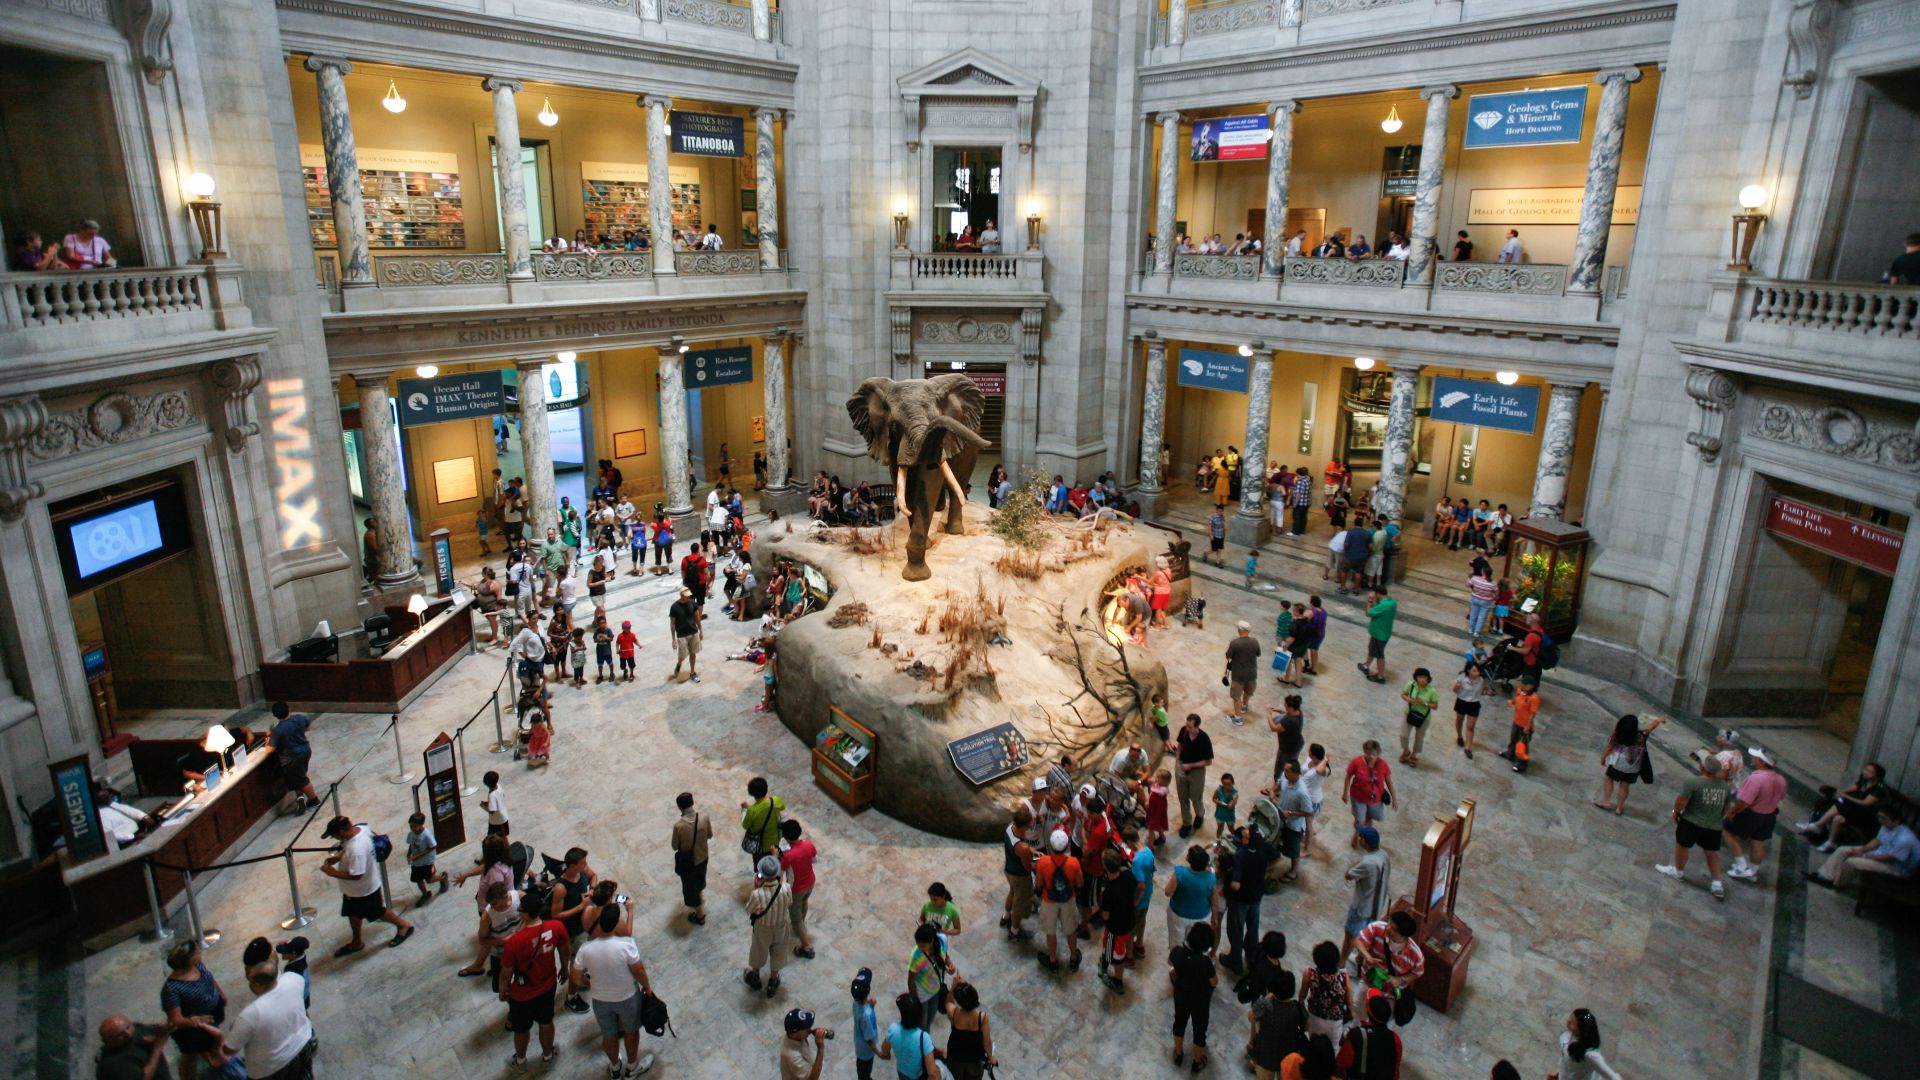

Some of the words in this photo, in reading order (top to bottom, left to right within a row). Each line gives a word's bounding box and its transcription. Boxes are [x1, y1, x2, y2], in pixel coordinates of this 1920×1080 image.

[1508, 103, 1548, 114] Geology,
[1551, 100, 1579, 110] Gems
[681, 114, 715, 124] NATURE'S
[717, 117, 734, 126] BEST
[1506, 116, 1515, 124] &
[1519, 112, 1561, 123] Minerals
[682, 123, 734, 134] PHOTOGRAPHY
[1505, 127, 1526, 135] HOPE
[1528, 126, 1562, 134] DIAMOND
[682, 135, 735, 152] TITANOBOA
[458, 325, 533, 344] KENNETH
[555, 320, 616, 336] BEHRING
[621, 317, 664, 332] FAMILY
[668, 313, 726, 327] ROTUNDA
[1207, 362, 1230, 371] Ancient
[1216, 371, 1228, 380] Age
[433, 384, 461, 394] Ocean
[462, 381, 481, 390] Hall
[464, 390, 498, 399] Theater
[1473, 393, 1498, 404] Early
[1500, 397, 1519, 406] Life
[436, 404, 468, 414] Human
[469, 400, 500, 412] Origins
[1472, 403, 1497, 414] Fossil
[1498, 406, 1528, 418] Plants
[267, 378, 321, 551] IMAX
[1783, 503, 1805, 516] EARLY
[1805, 510, 1822, 522] LIFE
[1781, 512, 1803, 526] FOSSIL
[1804, 520, 1832, 536] PLANTS
[1861, 528, 1901, 548] ELEVATOR
[436, 548, 448, 581] TICKETS
[64, 782, 89, 838] TICKETS
